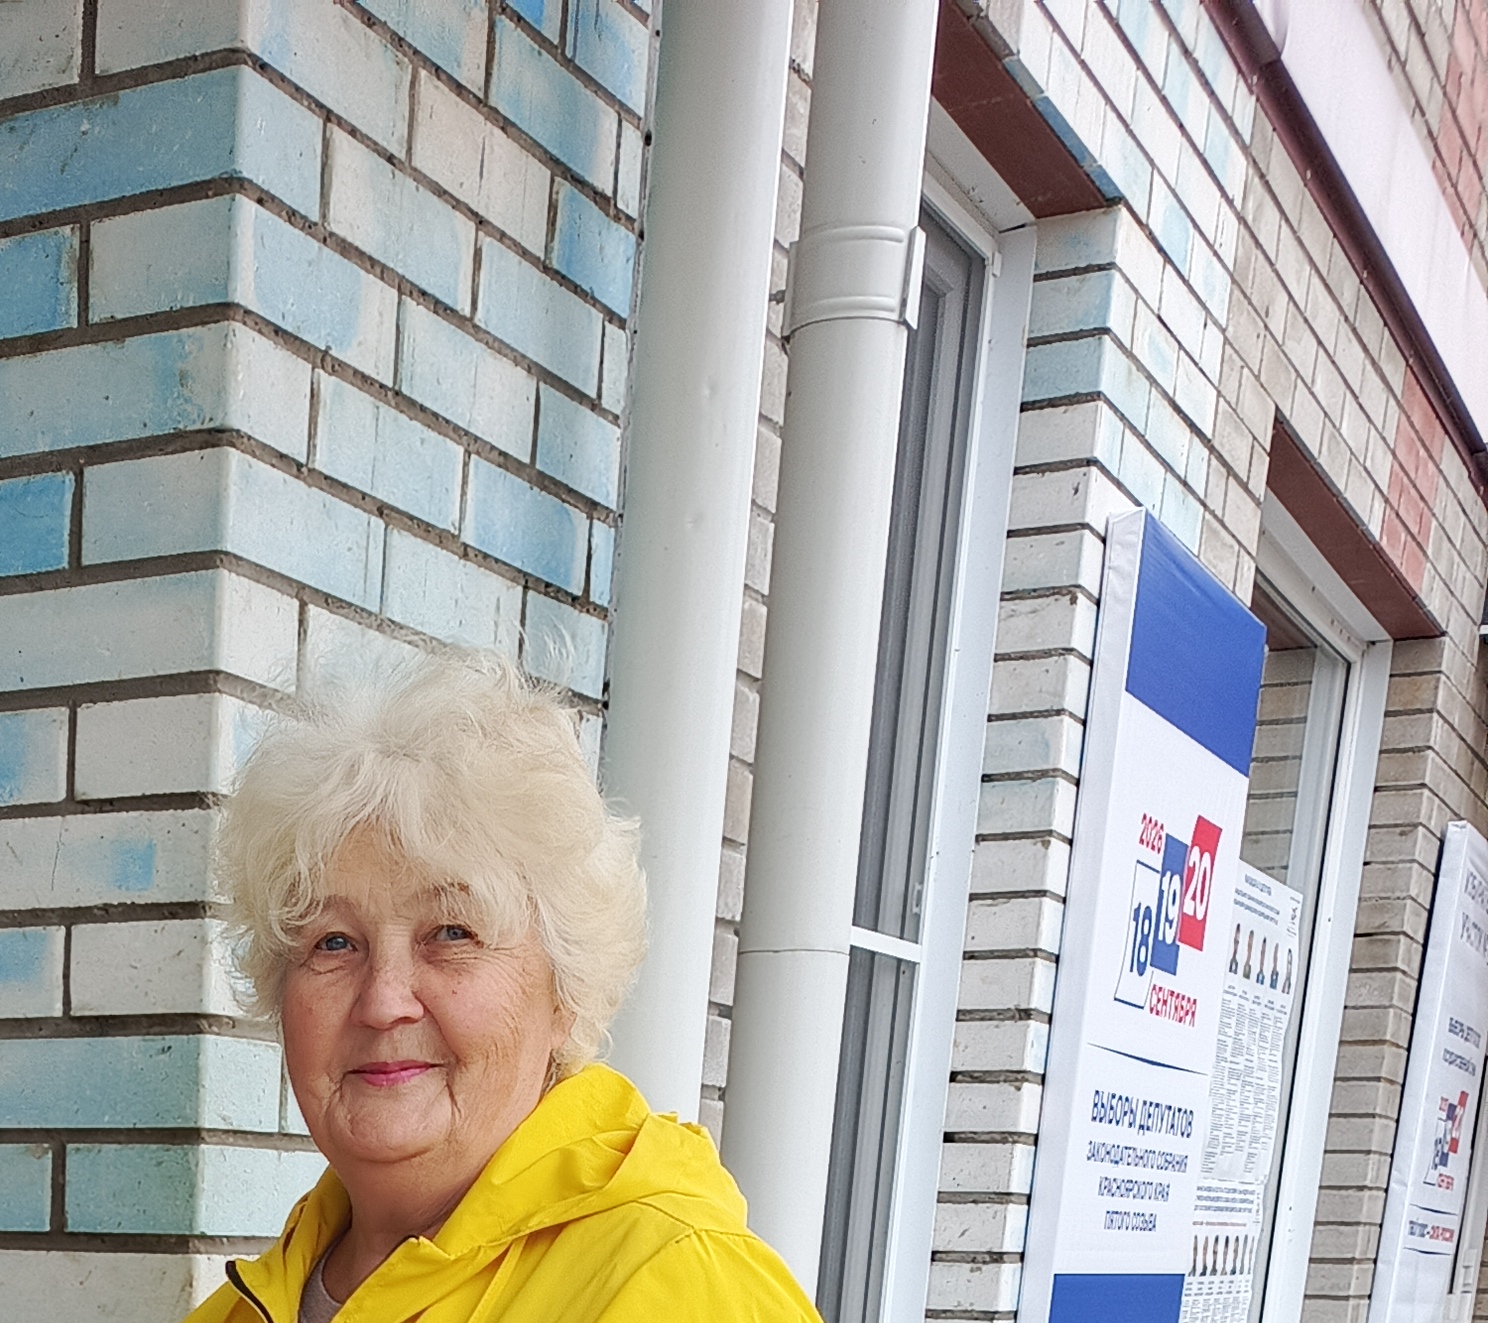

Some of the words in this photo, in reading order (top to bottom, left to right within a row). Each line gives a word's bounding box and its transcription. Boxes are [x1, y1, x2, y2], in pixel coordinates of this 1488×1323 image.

[1139, 812, 1164, 855] 2026
[1158, 870, 1182, 945] 19
[1183, 845, 1212, 921] 20
[1130, 901, 1153, 977] 18
[1091, 1089, 1139, 1129] ВЫБОРЫ
[1138, 1099, 1194, 1139] ДЕПУТАТОВ
